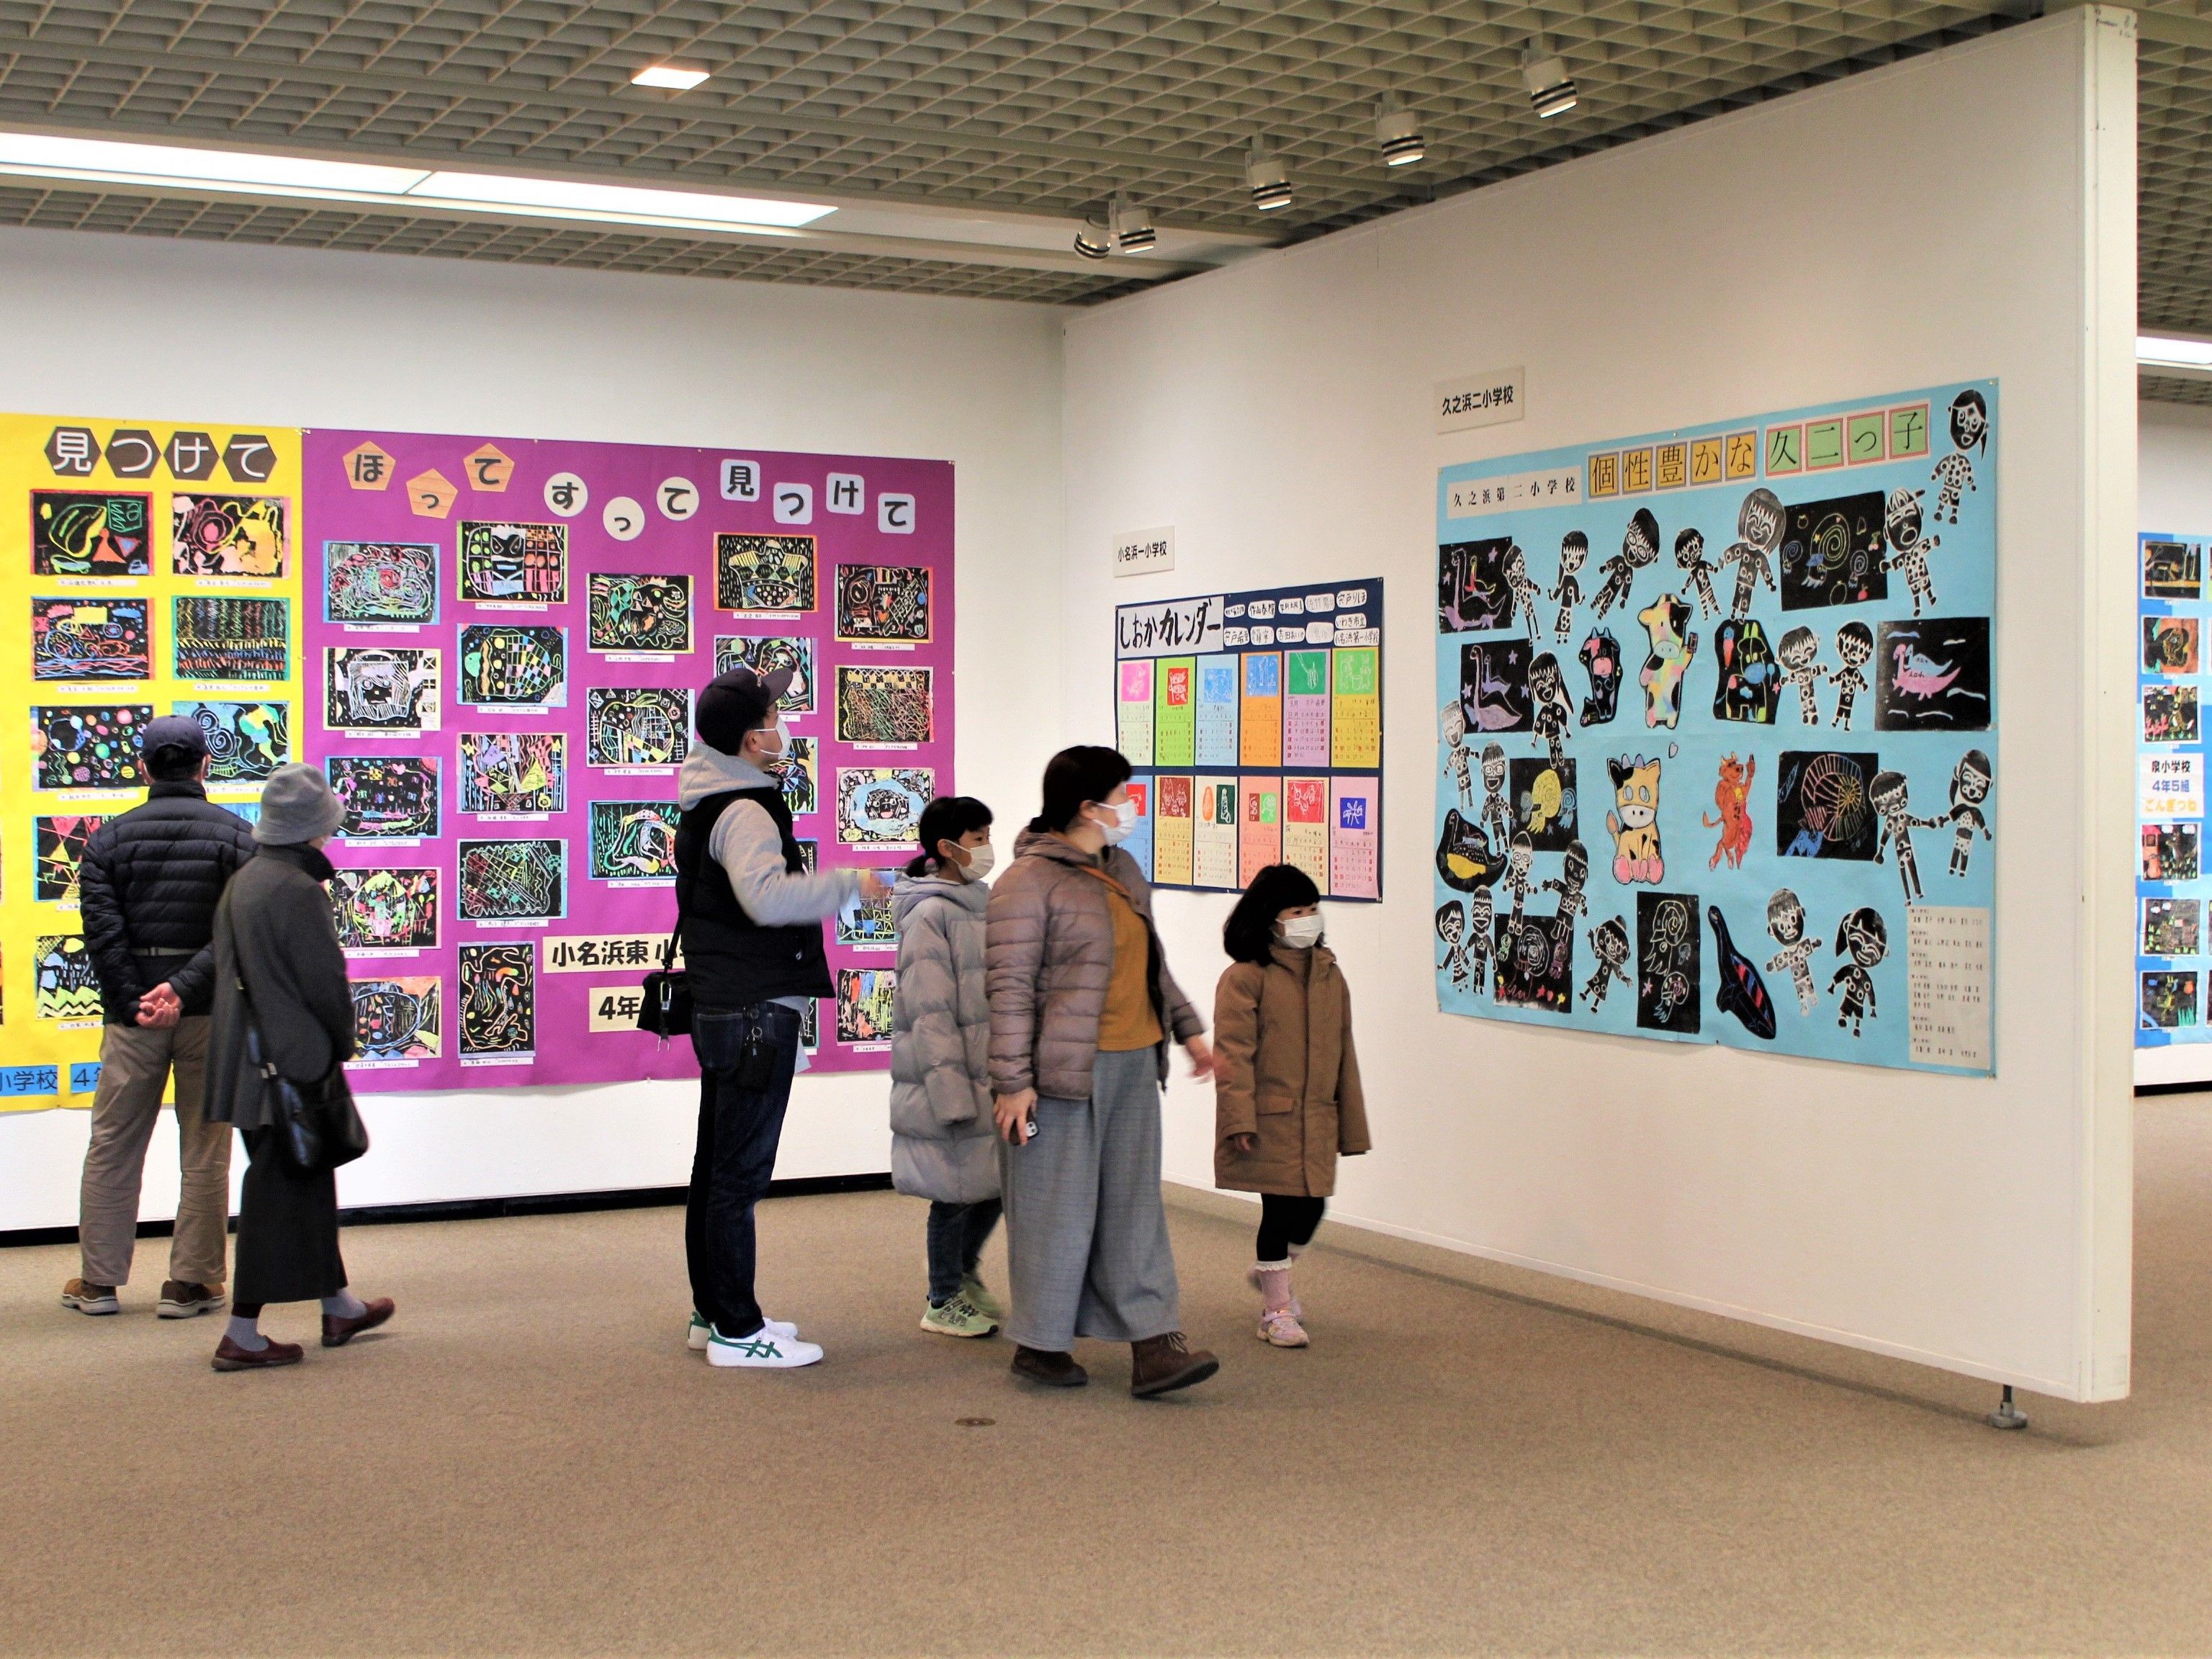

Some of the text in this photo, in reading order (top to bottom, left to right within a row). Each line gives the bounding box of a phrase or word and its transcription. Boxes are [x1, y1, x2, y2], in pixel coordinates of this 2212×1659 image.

[1442, 385, 1514, 415] 久之浜二小学校
[54, 433, 269, 477] 見つけて
[1454, 477, 1575, 507] 久之浜第二小学校
[1118, 541, 1167, 562] 小名浜一小学校
[2152, 780, 2190, 793] 4年5組
